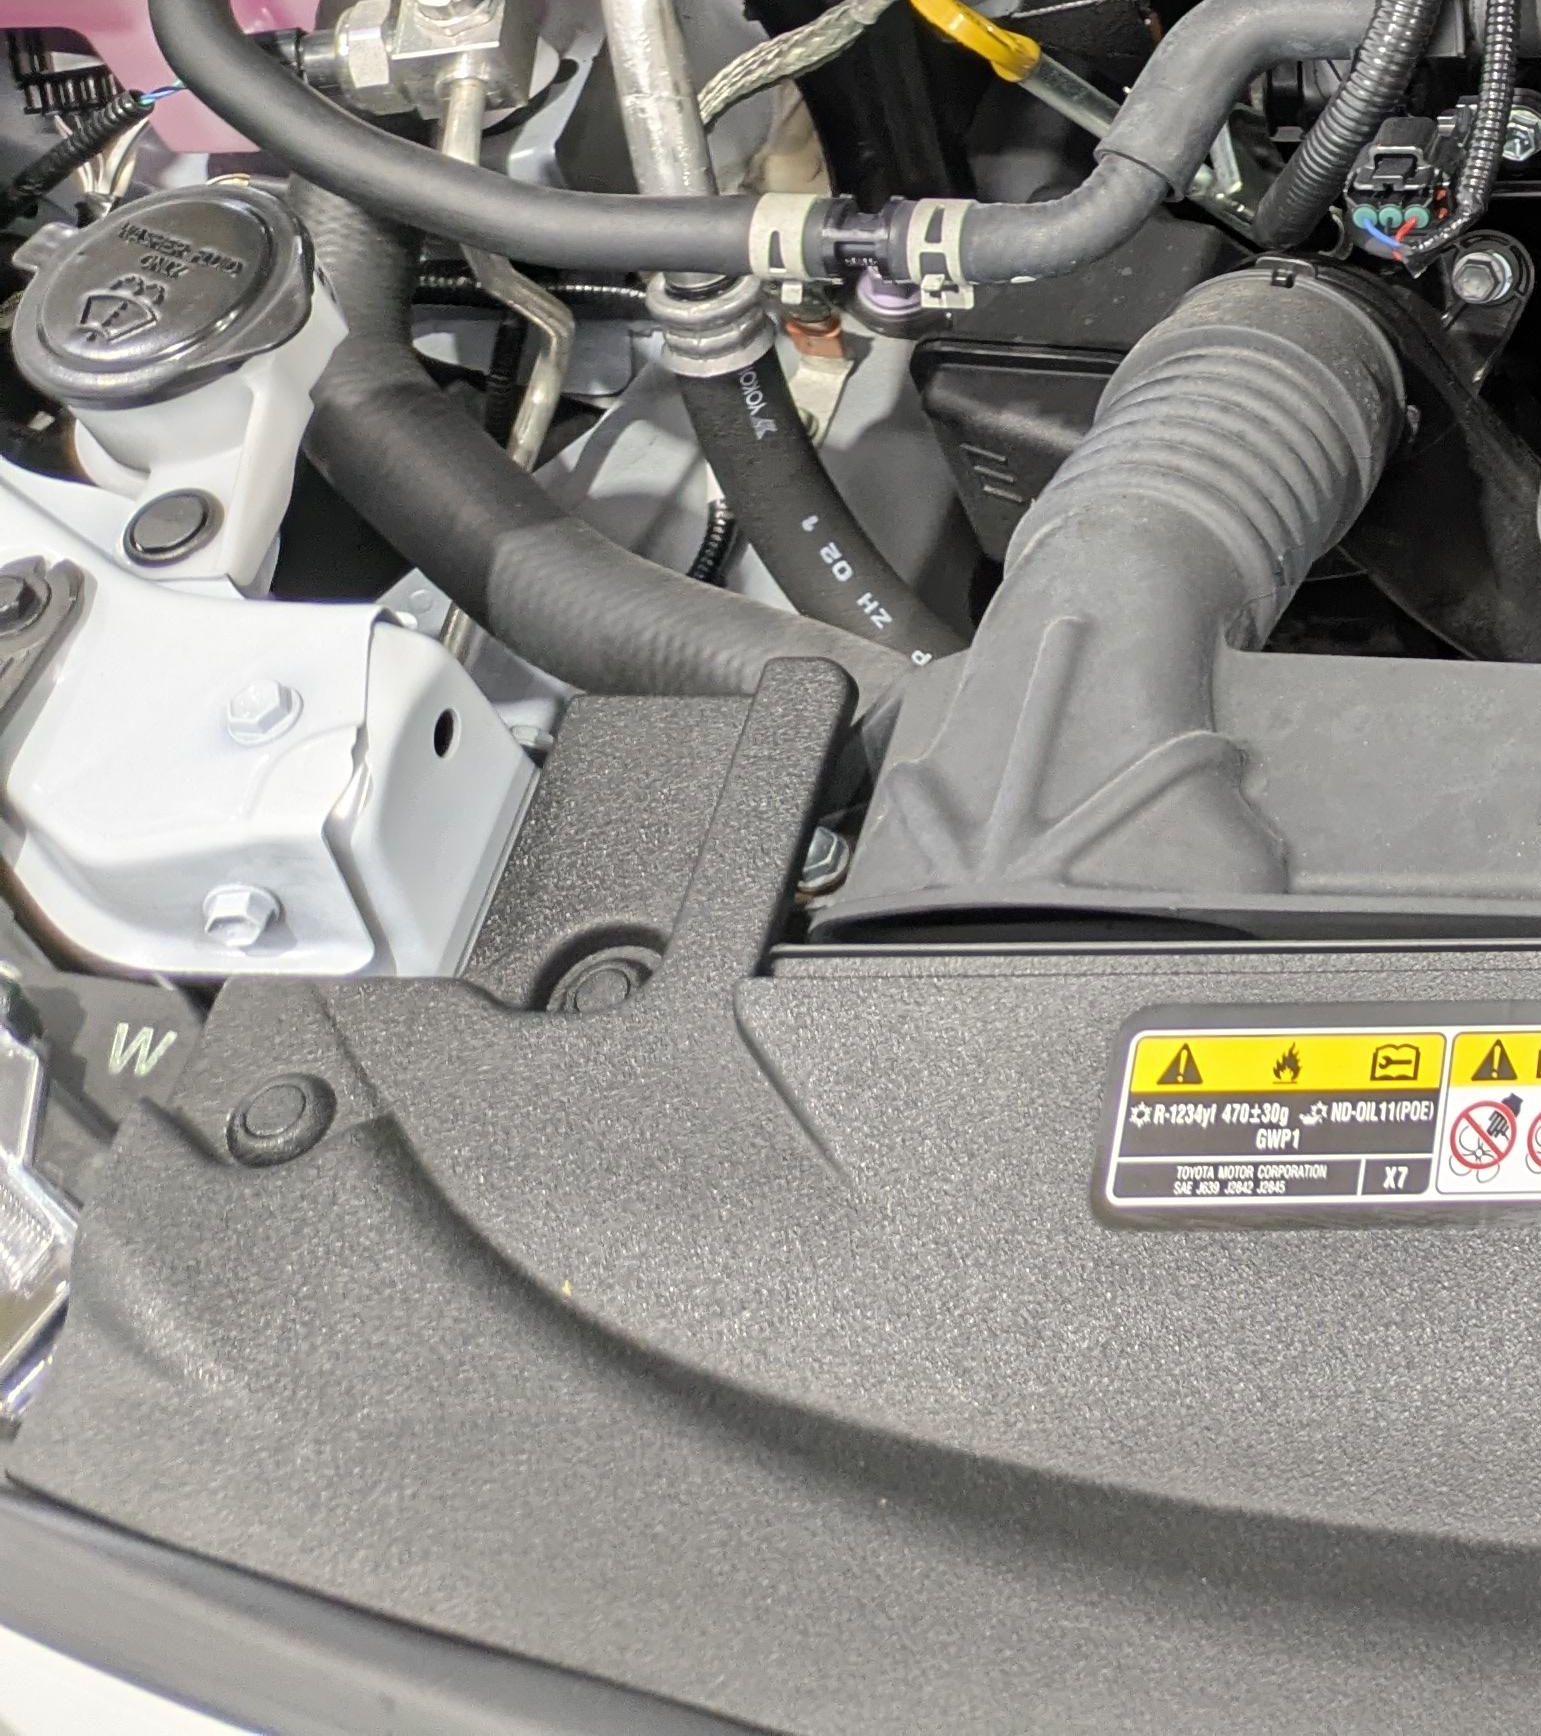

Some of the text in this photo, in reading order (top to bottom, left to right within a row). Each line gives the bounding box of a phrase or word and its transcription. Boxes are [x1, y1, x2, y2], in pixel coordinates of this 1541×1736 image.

[820, 542, 853, 582] 02
[857, 592, 892, 629] ZH
[108, 1022, 175, 1077] W
[1153, 1100, 1434, 1128] R-1234yf 470±30g ND-OIL11(POE)
[1255, 1128, 1300, 1150] GWP1
[1176, 1164, 1328, 1179] TOYOTA MOTOR CORPORATION
[1382, 1166, 1409, 1189] X7
[1173, 1181, 1193, 1195] SAE
